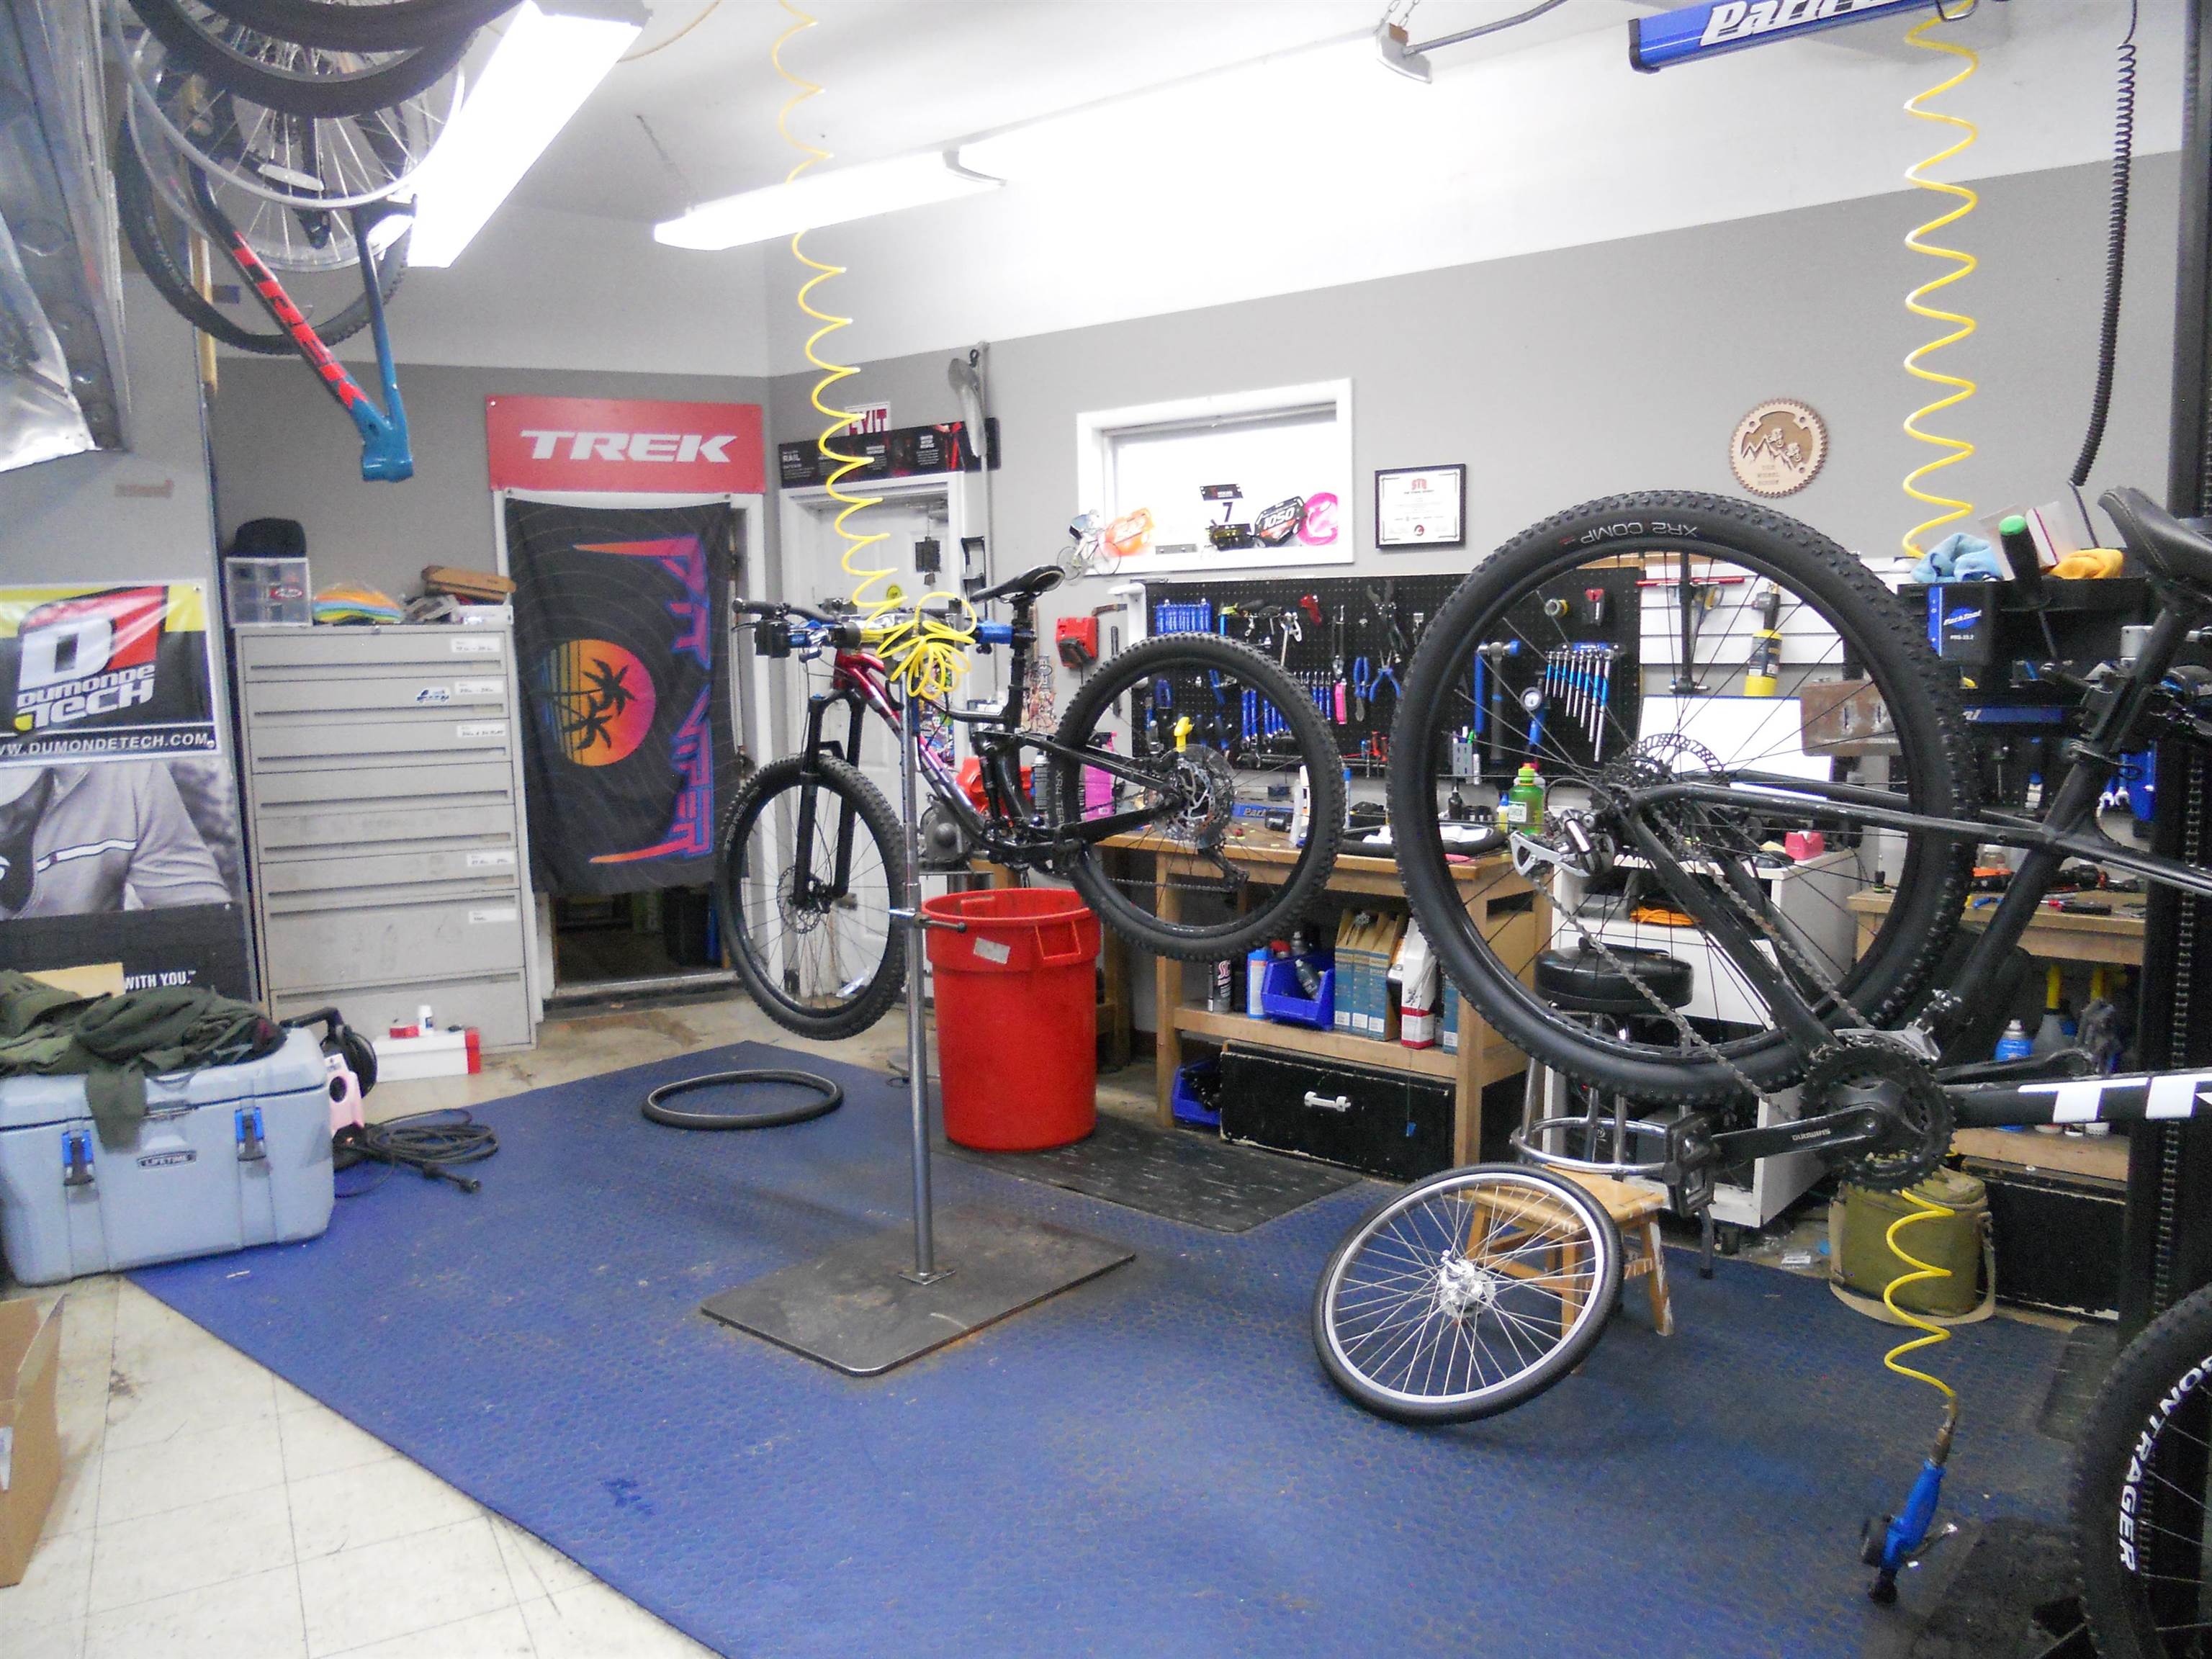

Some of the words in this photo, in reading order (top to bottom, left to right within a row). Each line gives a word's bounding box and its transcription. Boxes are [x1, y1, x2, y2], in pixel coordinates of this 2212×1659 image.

[520, 430, 737, 462] TREK
[1223, 502, 1233, 522] 7
[1263, 507, 1295, 529] 1050
[1581, 522, 1643, 544] COMP
[1651, 521, 1698, 538] XR2
[1055, 770, 1064, 795] XR4
[1055, 799, 1065, 824] TEA
[125, 974, 157, 990] WITH
